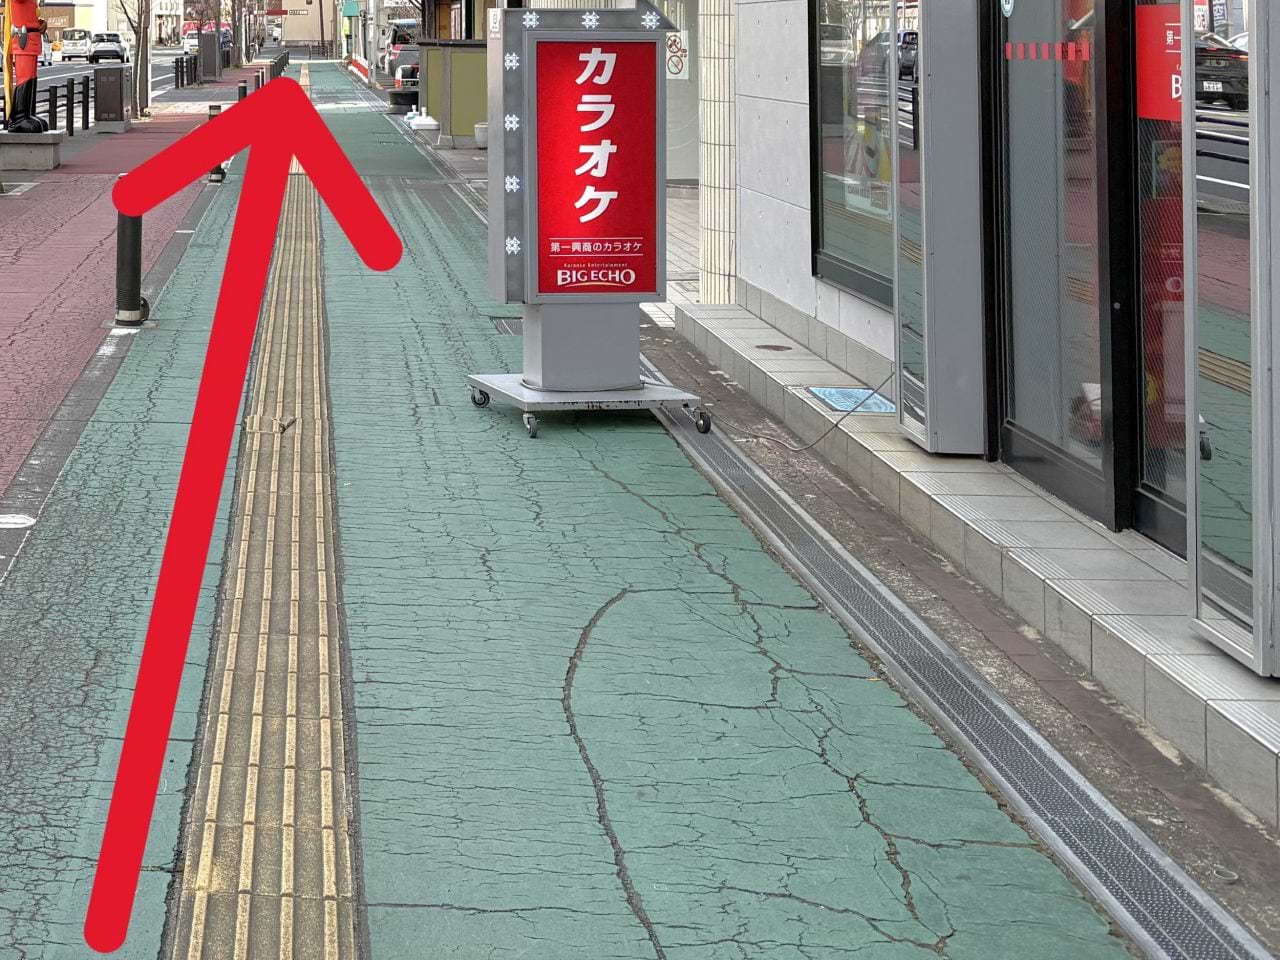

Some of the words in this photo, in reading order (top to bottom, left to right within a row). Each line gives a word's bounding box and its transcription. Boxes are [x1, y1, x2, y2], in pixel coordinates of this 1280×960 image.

[575, 47, 619, 224] カラオケ
[551, 242, 642, 253] 第一興商のカラオケ
[557, 270, 588, 285] BIG
[591, 269, 636, 284] ECHO
